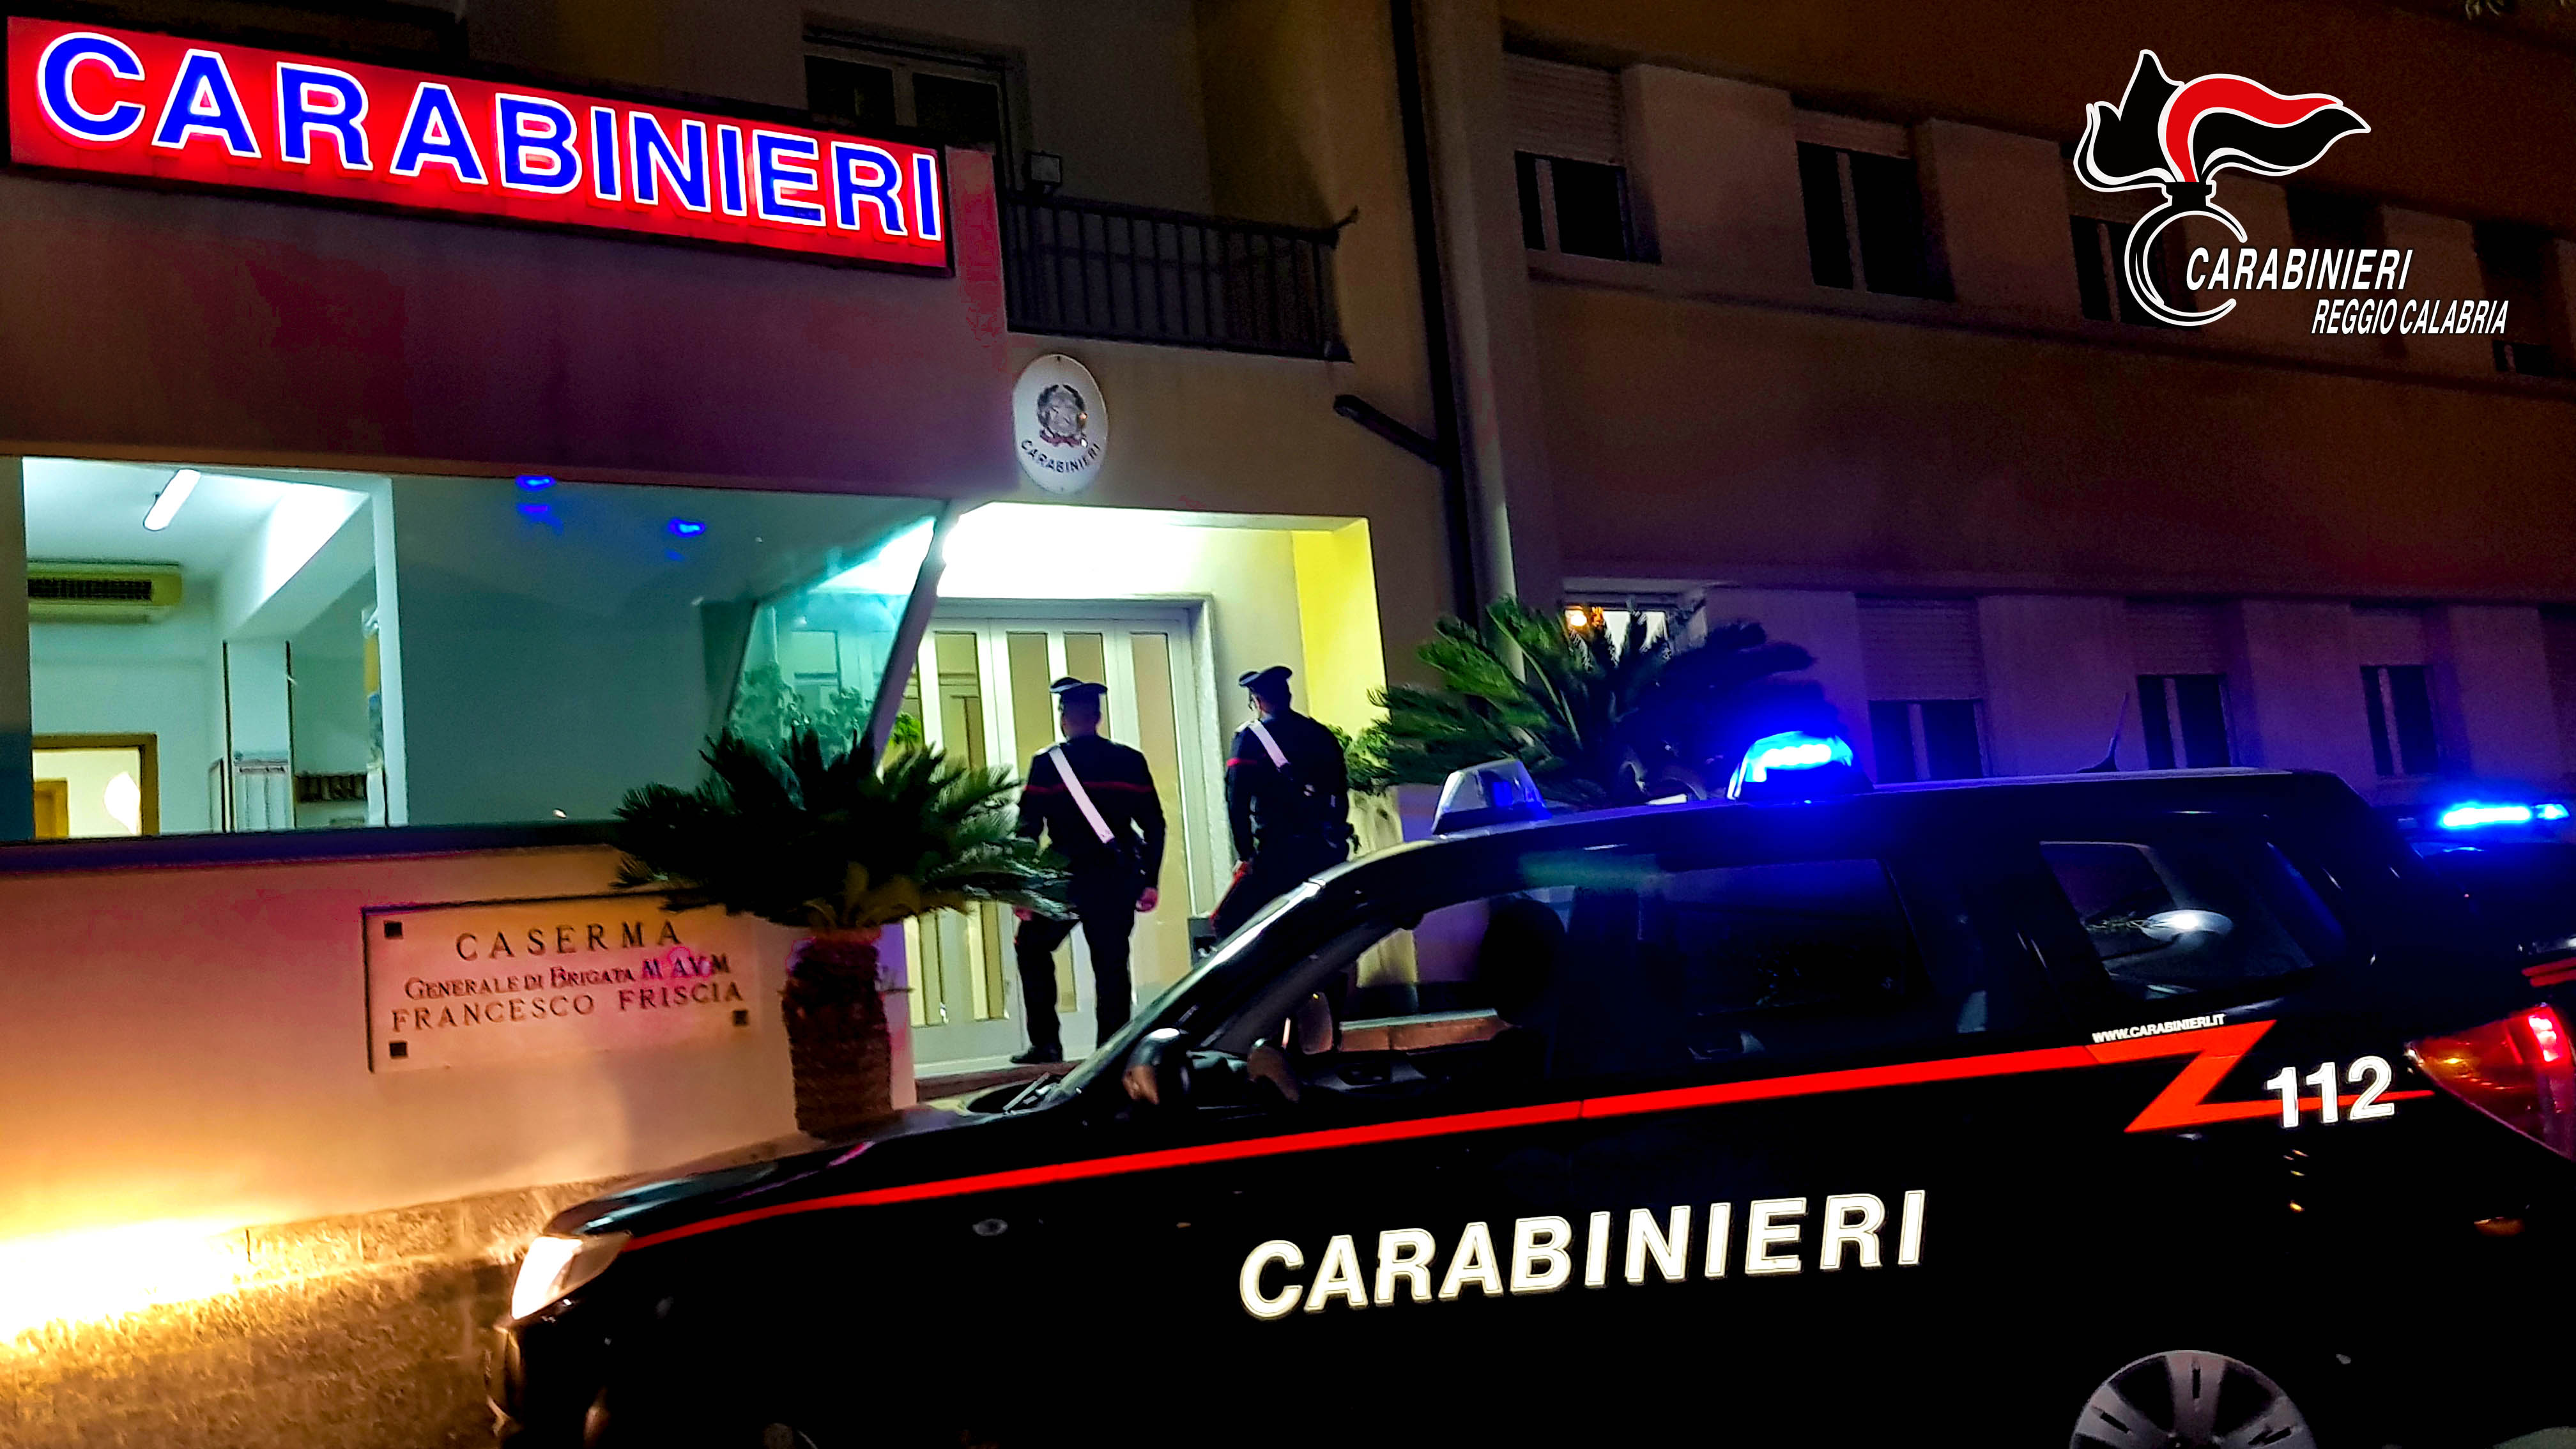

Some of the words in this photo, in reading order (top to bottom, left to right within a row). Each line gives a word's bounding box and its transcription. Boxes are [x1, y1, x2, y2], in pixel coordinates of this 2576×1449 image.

[36, 31, 942, 241] CARABINIERI
[1022, 440, 1101, 473] CARABINIERI
[456, 921, 682, 960] CASERMA
[391, 995, 595, 1032] FRANCESCO
[619, 982, 744, 1013] FRISCIA
[2092, 1013, 2225, 1043] WWW.CARABINIERI.IT
[2266, 1055, 2395, 1128] 112
[1238, 1189, 1926, 1321] CARABINIERI
